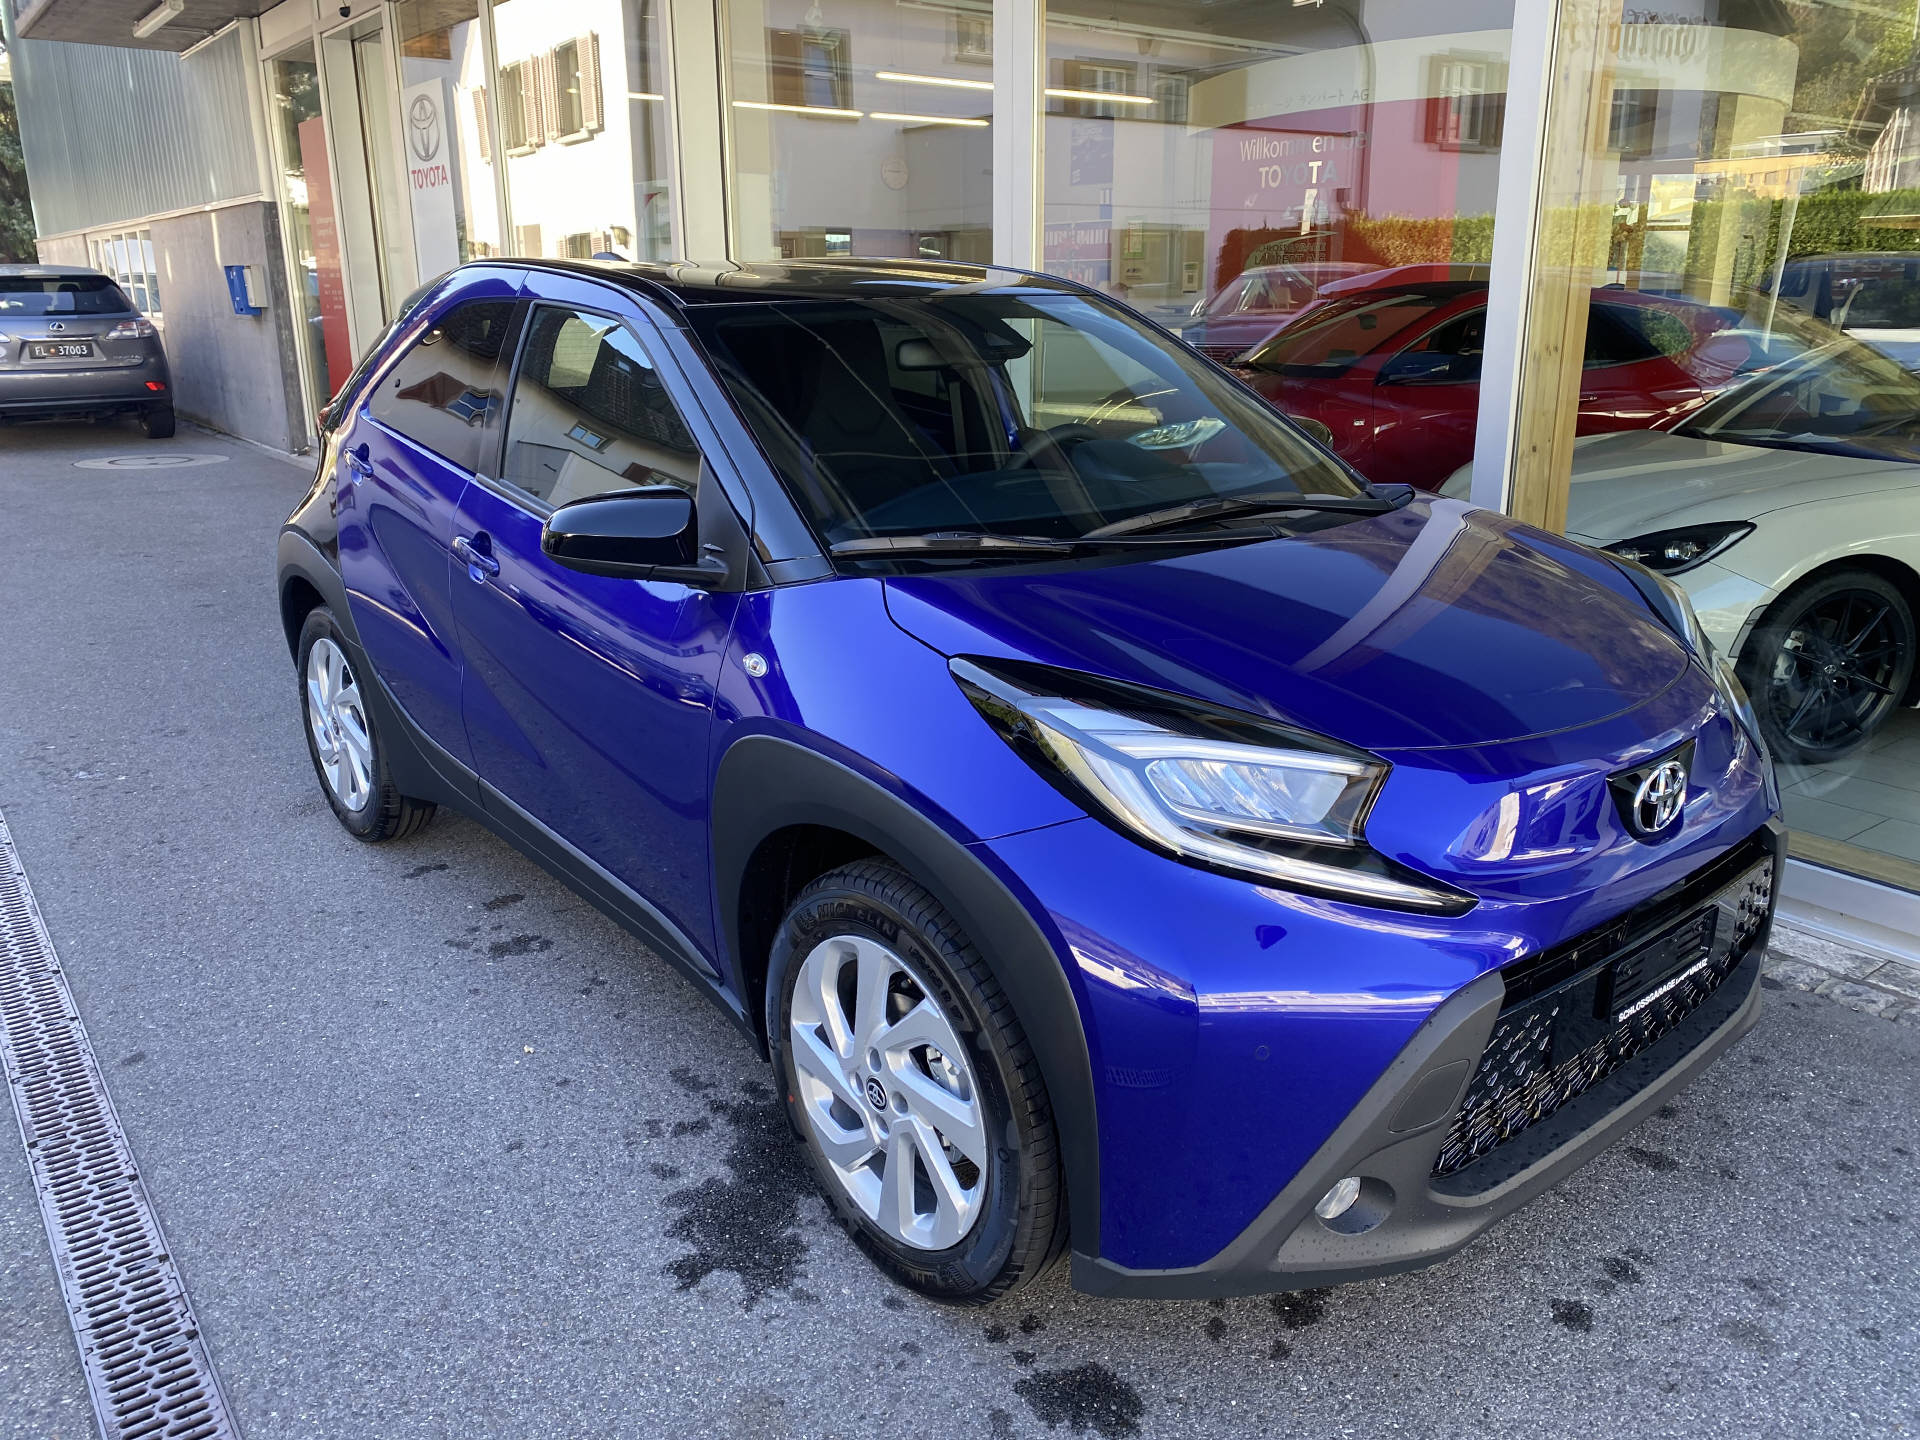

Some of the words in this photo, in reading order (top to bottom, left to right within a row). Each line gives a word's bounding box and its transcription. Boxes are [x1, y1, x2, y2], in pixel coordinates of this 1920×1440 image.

[411, 164, 449, 190] TOYOTA
[1259, 160, 1338, 188] TOYOTA
[35, 346, 47, 356] FL
[58, 345, 88, 355] 37003
[1618, 978, 1676, 1022] SCHLOSSGARAGE
